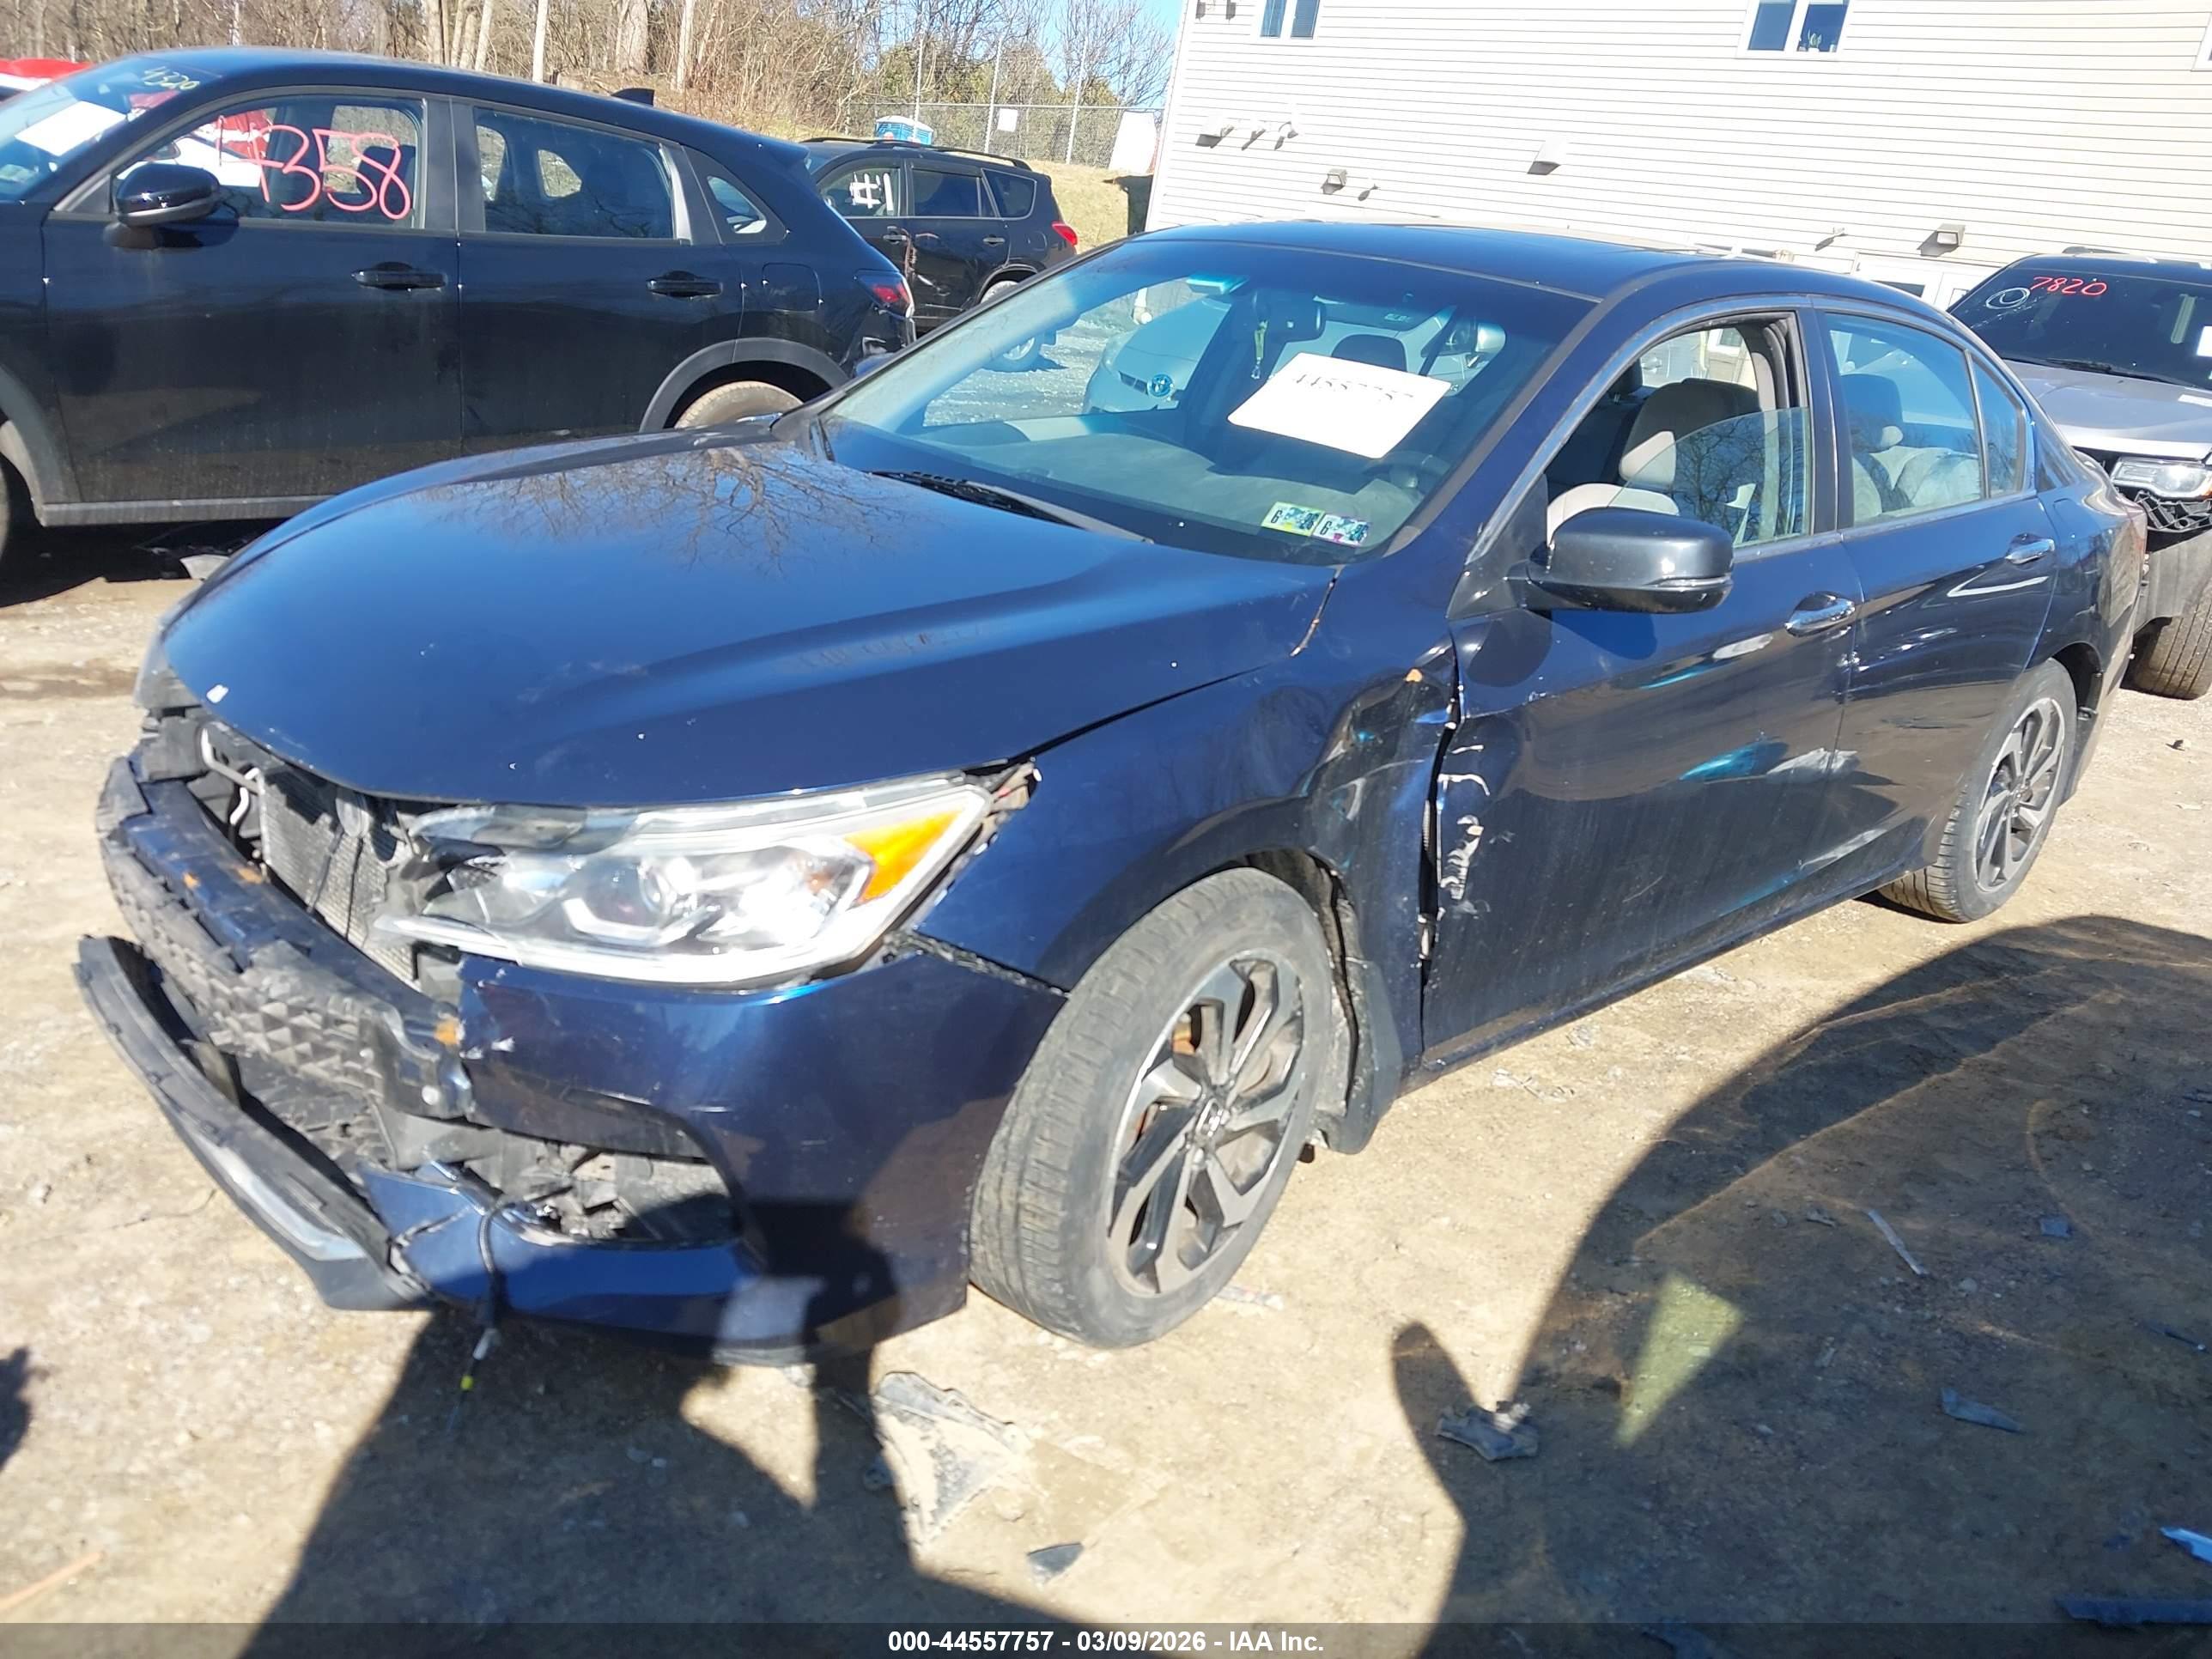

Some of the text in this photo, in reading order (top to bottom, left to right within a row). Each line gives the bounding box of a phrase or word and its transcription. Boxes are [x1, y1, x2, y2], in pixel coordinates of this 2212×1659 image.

[849, 172, 894, 211] #1
[2029, 276, 2108, 296] 7820
[1271, 509, 1283, 524] 6
[1320, 520, 1332, 535] 6
